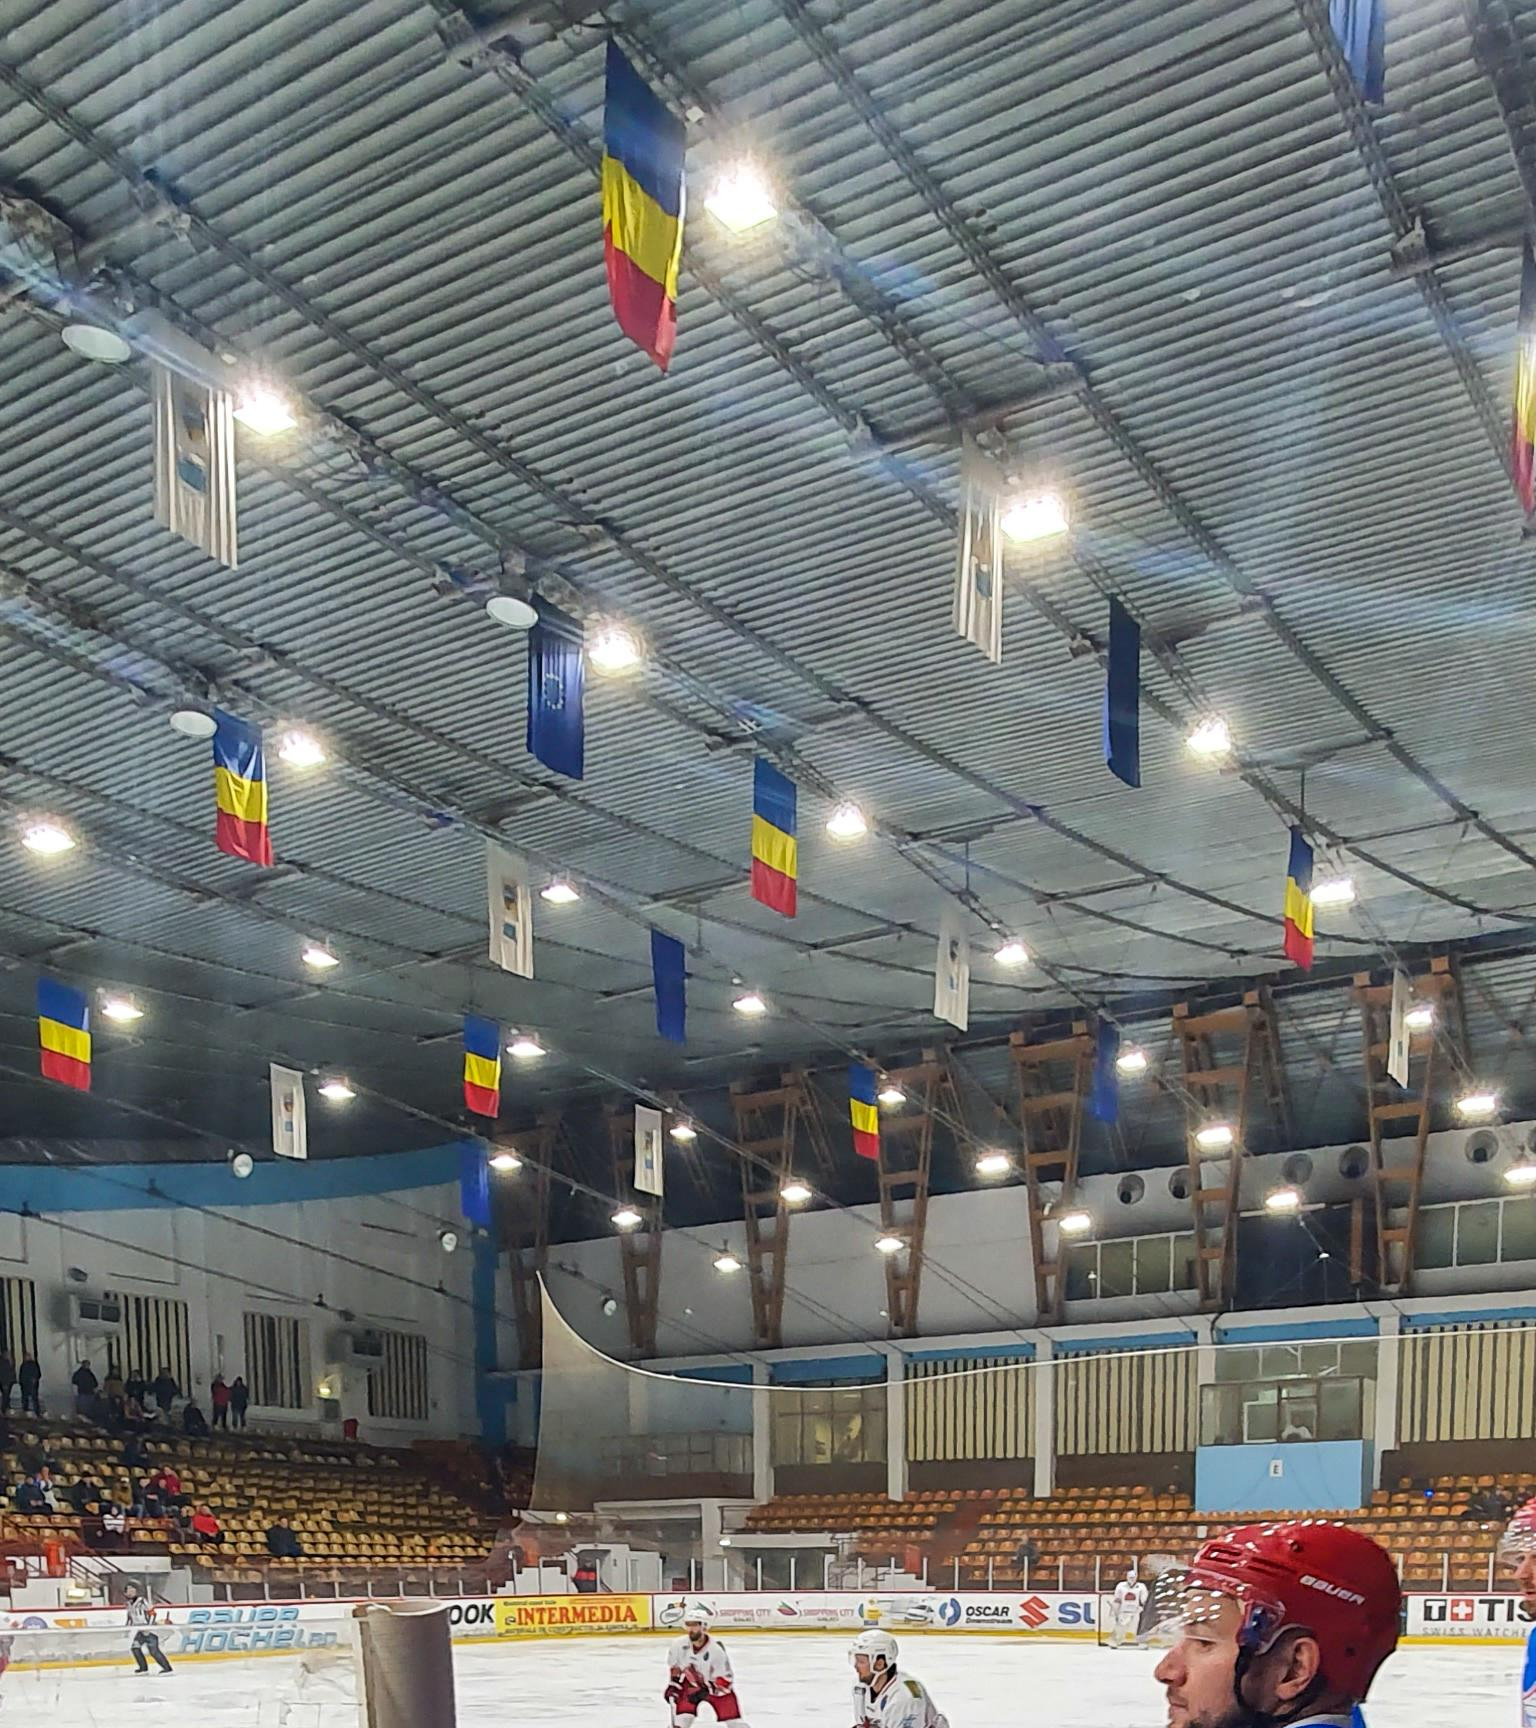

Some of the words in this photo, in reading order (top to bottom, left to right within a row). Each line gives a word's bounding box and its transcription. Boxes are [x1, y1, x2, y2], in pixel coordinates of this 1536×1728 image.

[1299, 1574, 1365, 1605] BAUER
[187, 1607, 299, 1630] BAUER
[516, 1605, 638, 1626] INTERMEDIA
[966, 1606, 1010, 1616] OSCAR
[1422, 1627, 1464, 1637] SWISS
